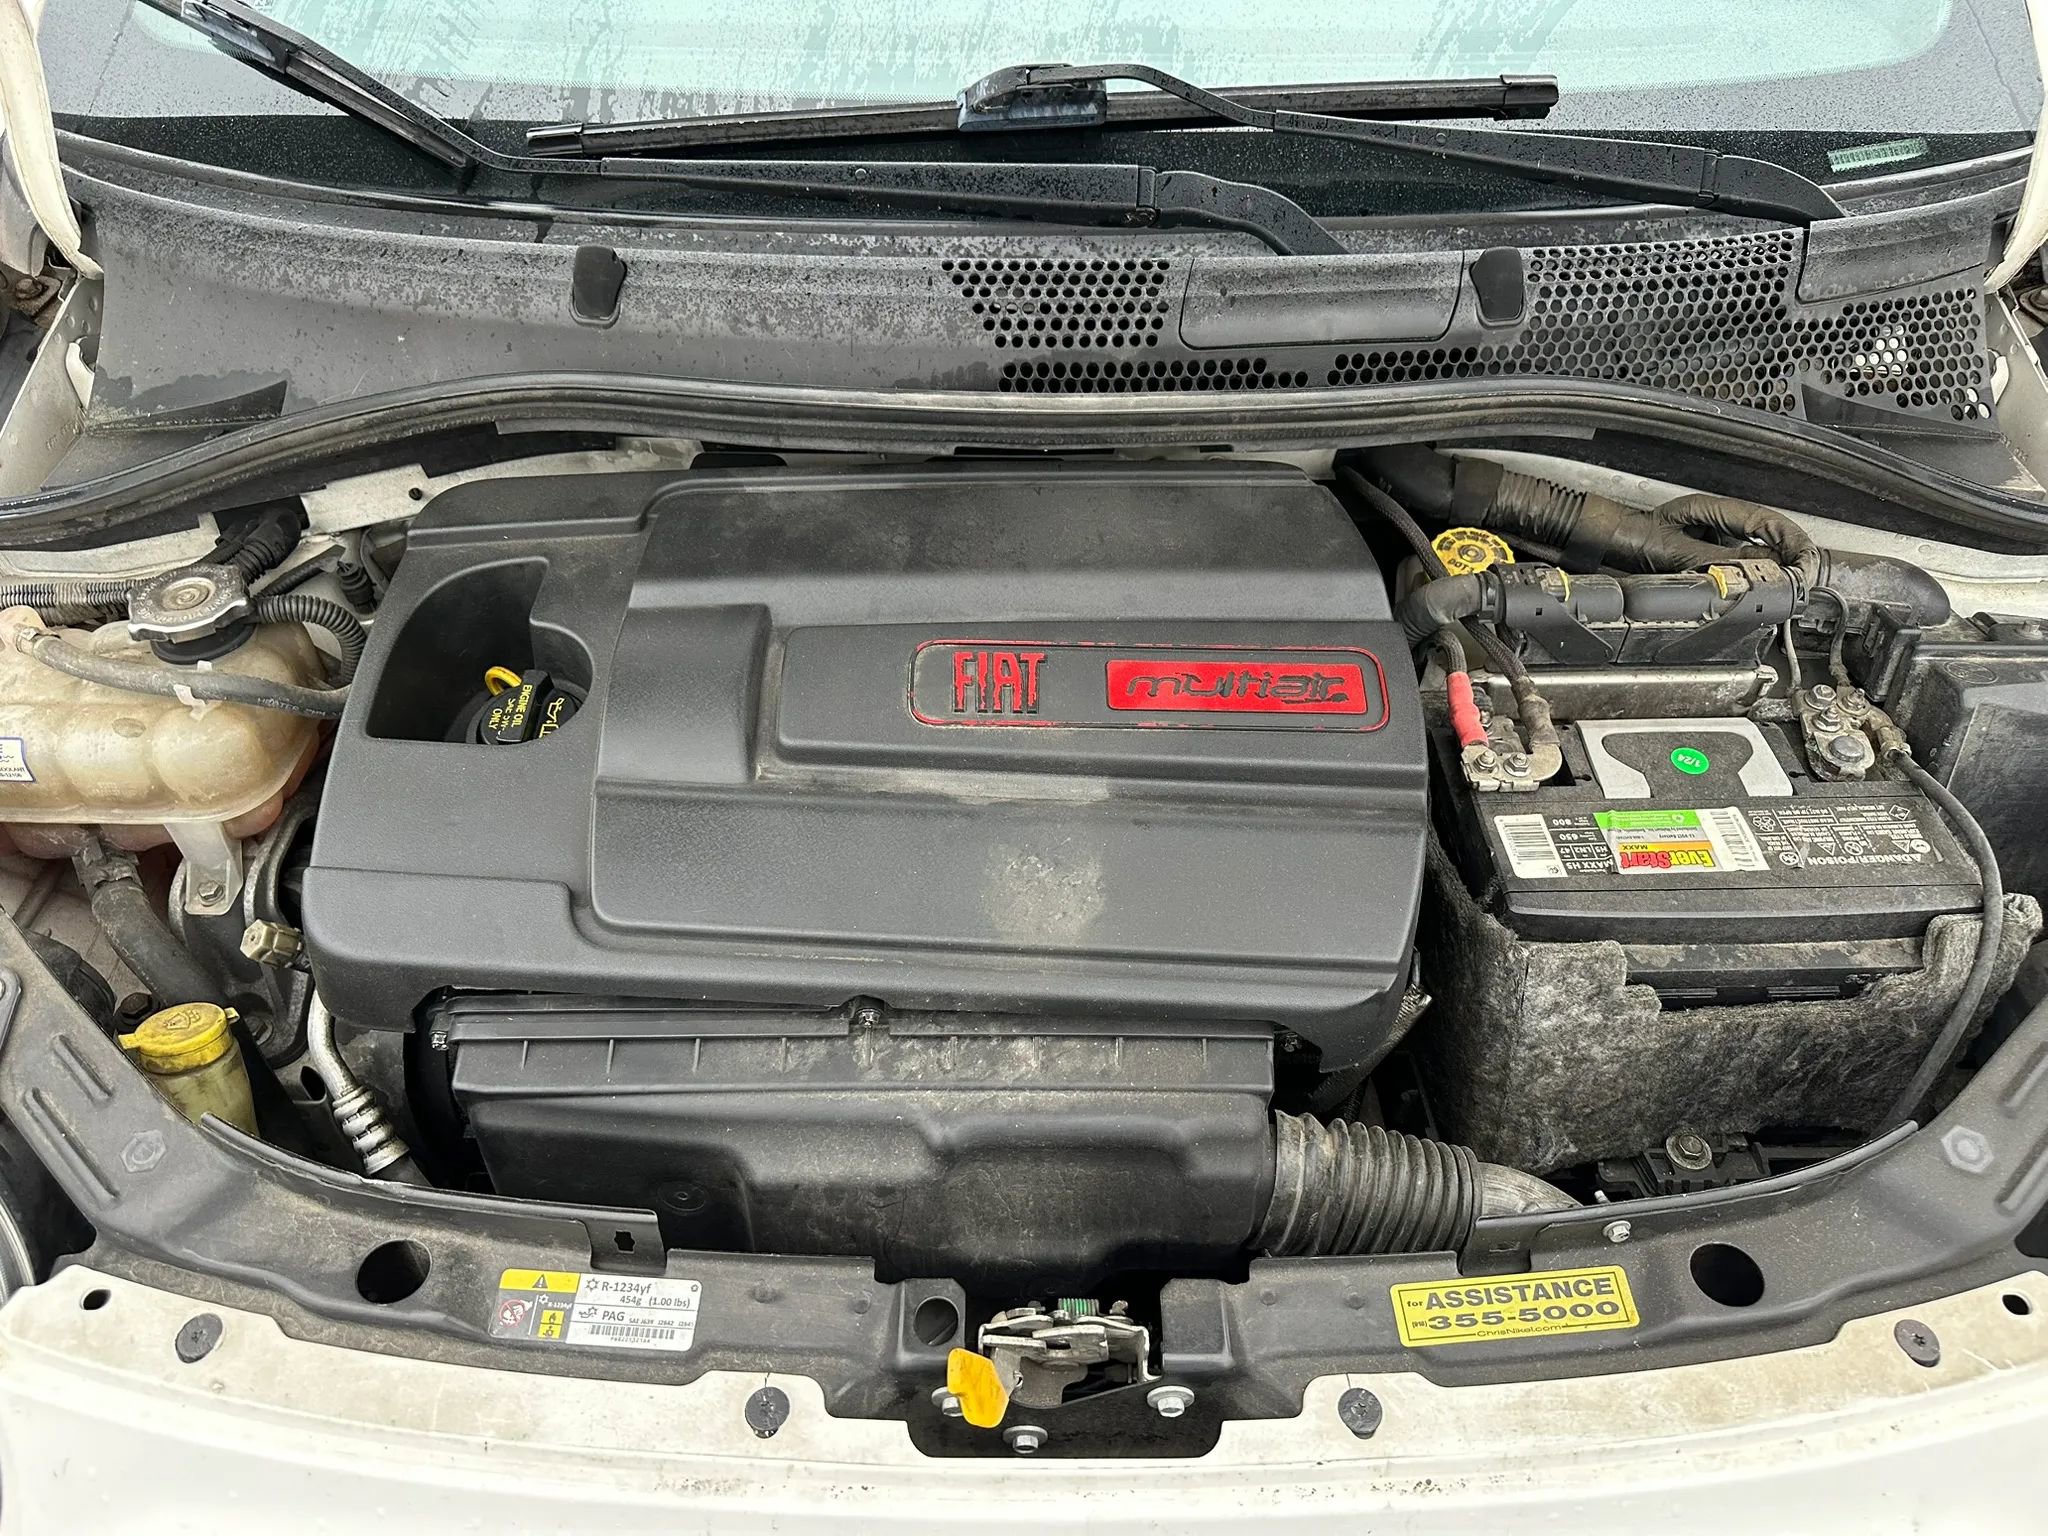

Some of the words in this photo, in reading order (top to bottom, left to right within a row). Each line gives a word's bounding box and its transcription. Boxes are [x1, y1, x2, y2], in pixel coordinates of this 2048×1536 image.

[953, 652, 1046, 714] FIAT
[517, 684, 533, 713] ENGINE
[488, 708, 503, 730] ONLY
[511, 713, 524, 728] OIL
[1581, 858, 1613, 869] MAXX
[1619, 849, 1715, 869] EverStart
[601, 1281, 652, 1296] R-1234yf
[1425, 1277, 1615, 1311] ASSISTANCE
[619, 1295, 642, 1306] 454g
[649, 1296, 672, 1307] (1.00
[674, 1297, 691, 1308] lbs)
[602, 1310, 626, 1322] PAG
[1428, 1301, 1620, 1330] 355-5000
[1477, 1324, 1562, 1337] ChrisNikel.com
